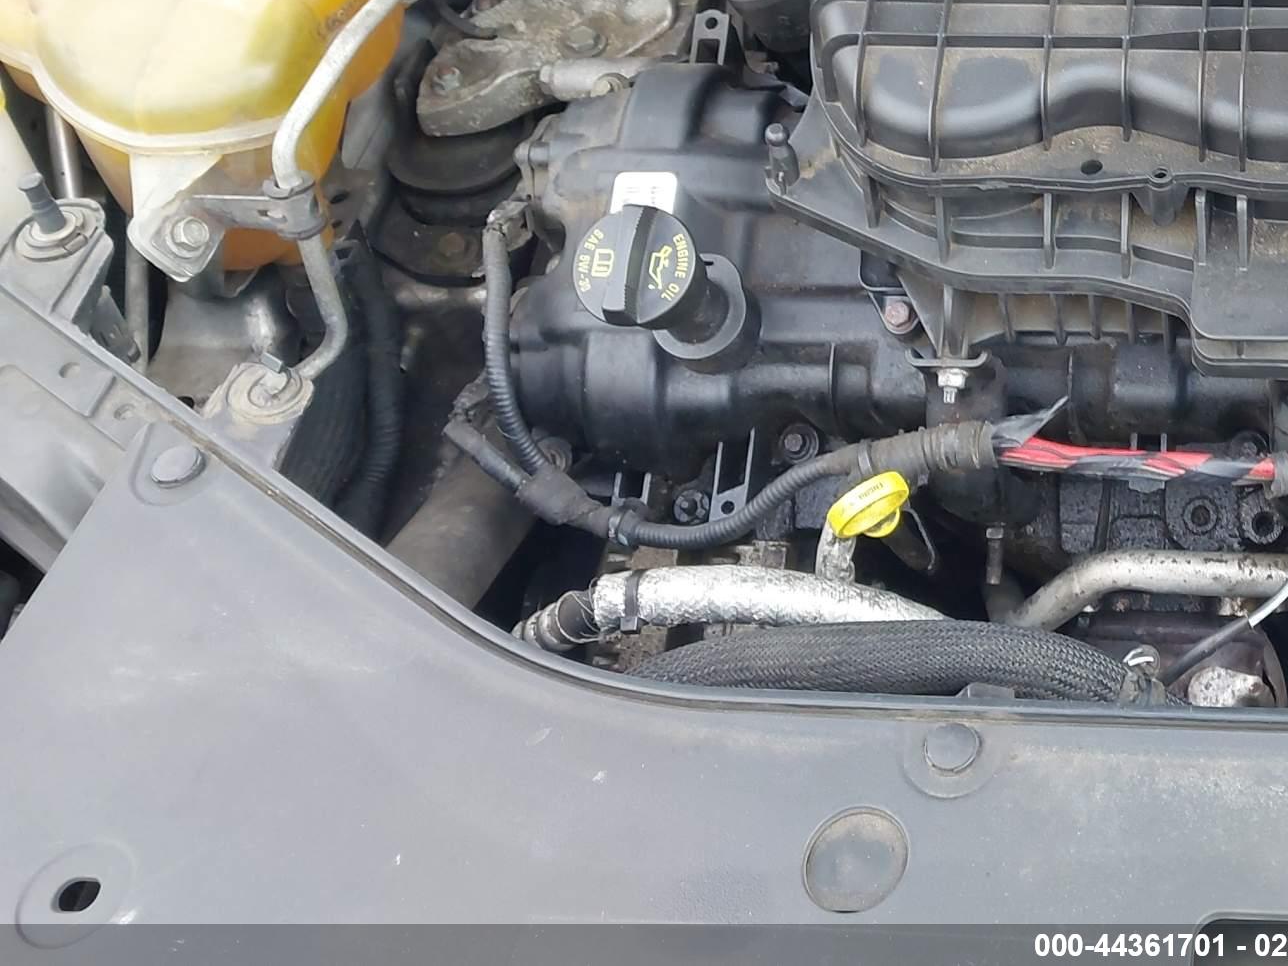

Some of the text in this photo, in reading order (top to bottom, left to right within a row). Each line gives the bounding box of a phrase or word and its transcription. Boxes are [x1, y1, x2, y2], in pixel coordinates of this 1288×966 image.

[583, 228, 605, 252] SAE
[660, 233, 690, 302] ENGINE OIL
